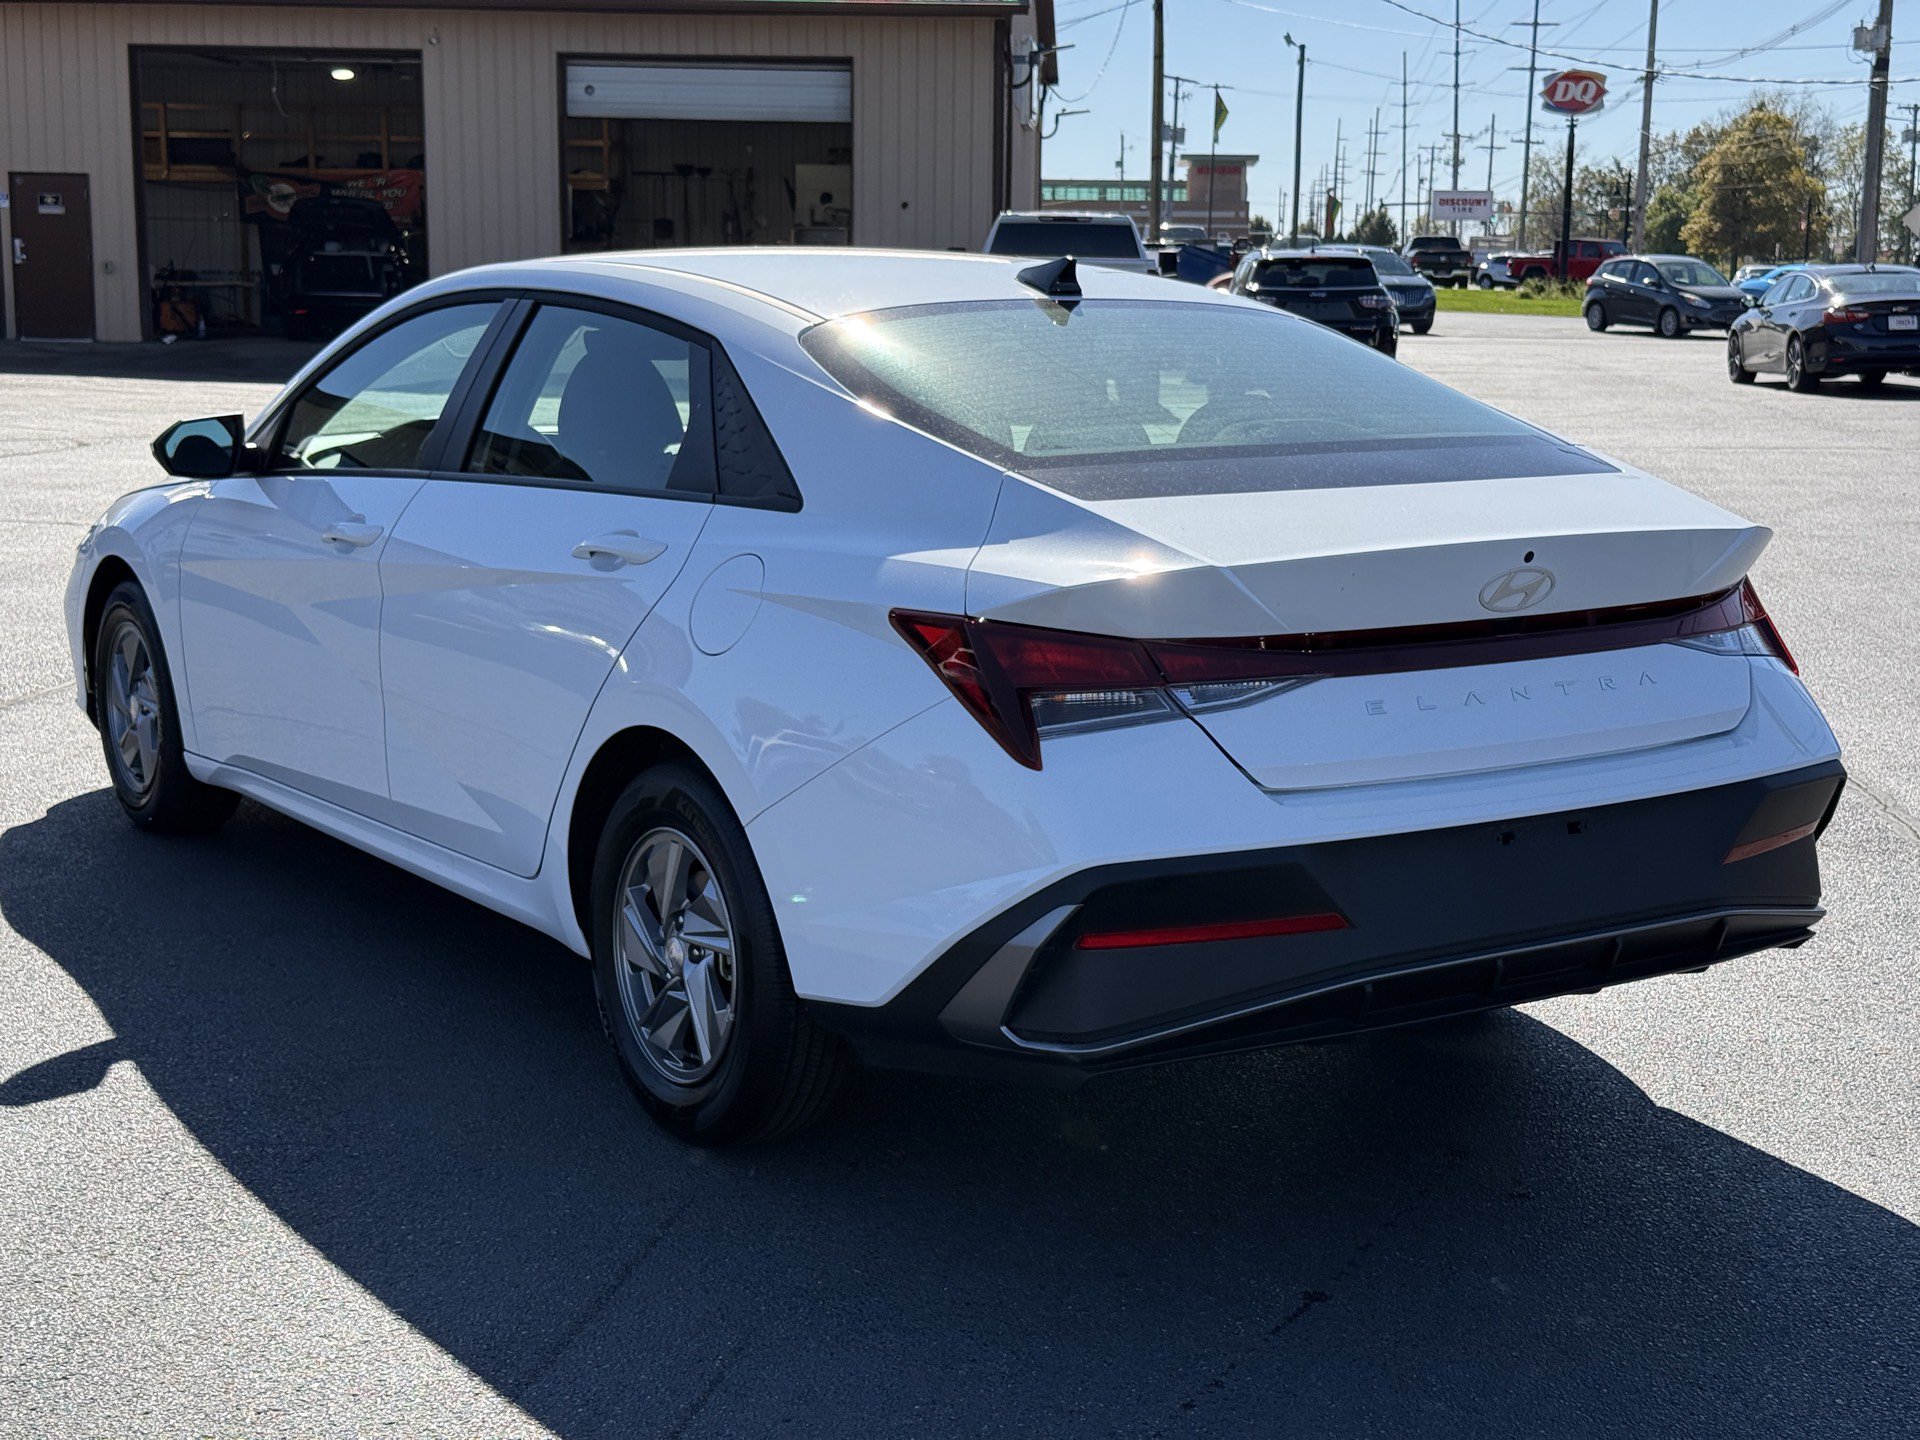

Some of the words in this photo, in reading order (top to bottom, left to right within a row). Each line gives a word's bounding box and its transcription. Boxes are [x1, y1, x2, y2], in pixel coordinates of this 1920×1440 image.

[1552, 79, 1598, 105] DQ
[382, 187, 407, 198] YOU
[1438, 197, 1489, 206] DISCOUNT
[1452, 206, 1473, 214] TIRE
[1364, 669, 1658, 716] ELANTRA
